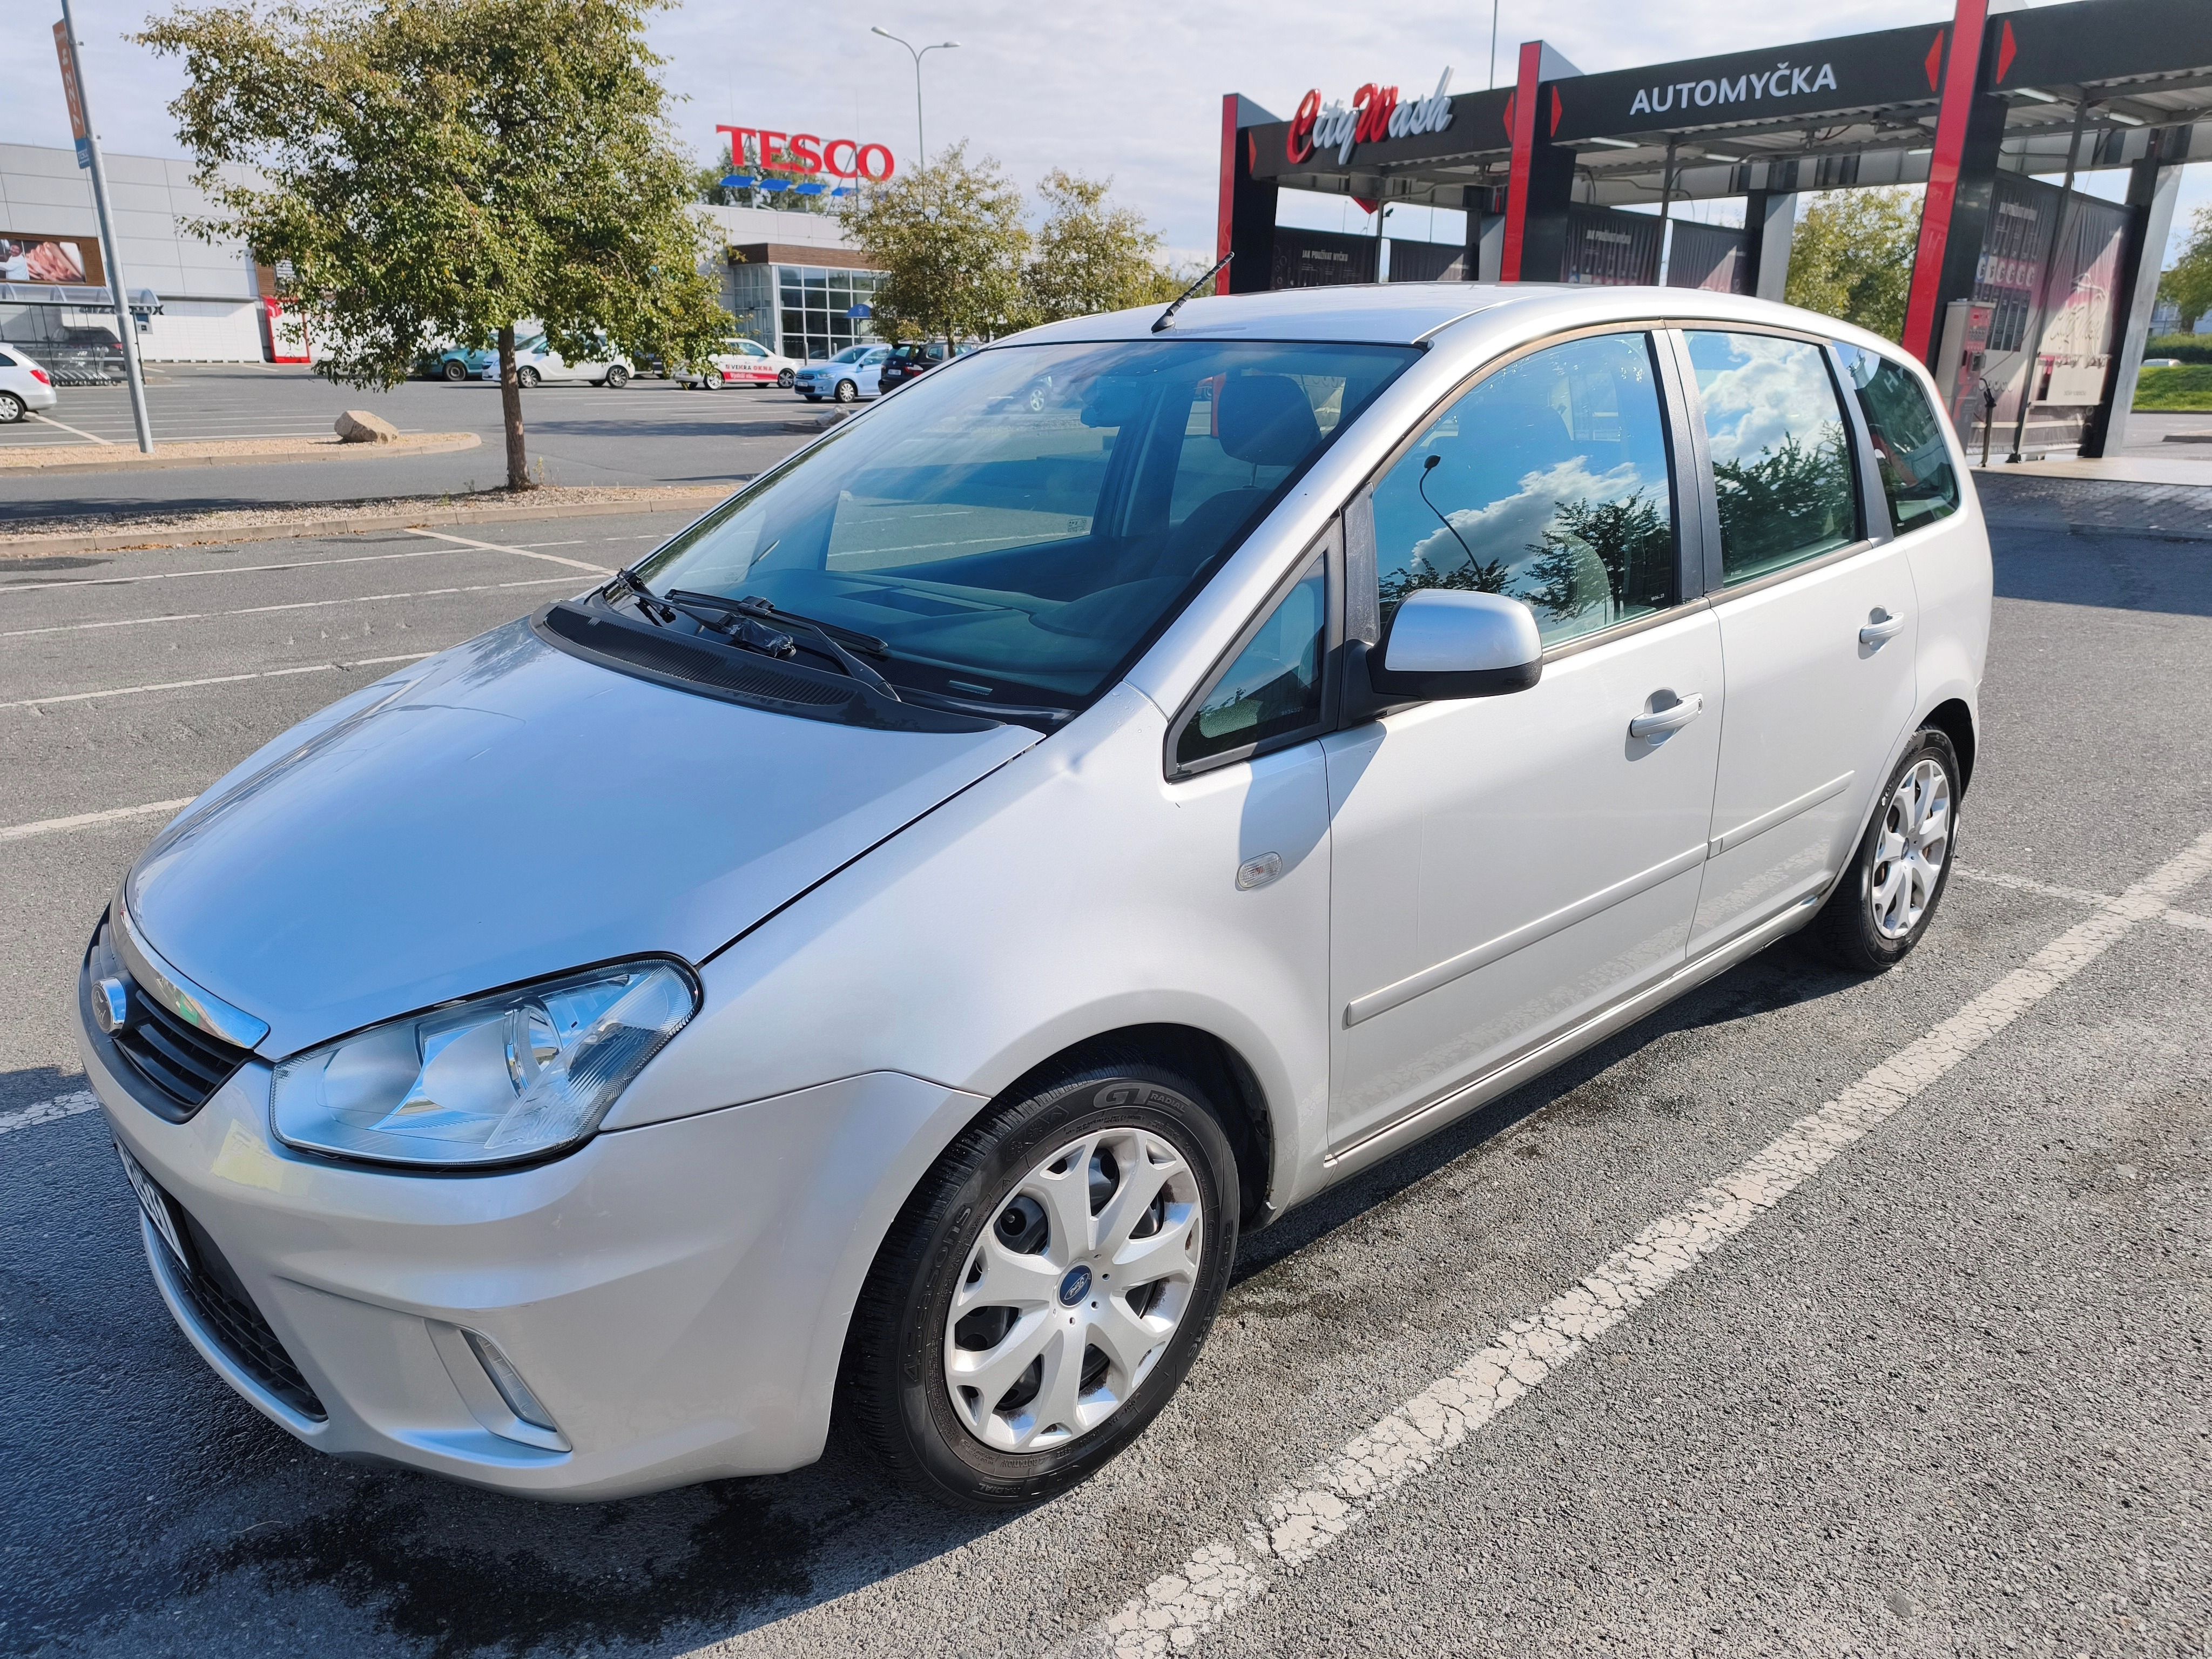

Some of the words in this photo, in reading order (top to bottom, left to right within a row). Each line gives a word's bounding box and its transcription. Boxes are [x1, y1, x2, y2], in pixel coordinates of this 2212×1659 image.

[1629, 62, 1837, 116] AUTOMYČKA
[716, 124, 895, 182] TESCO
[1093, 1082, 1159, 1108] GT
[1150, 1092, 1186, 1113] RADIAL
